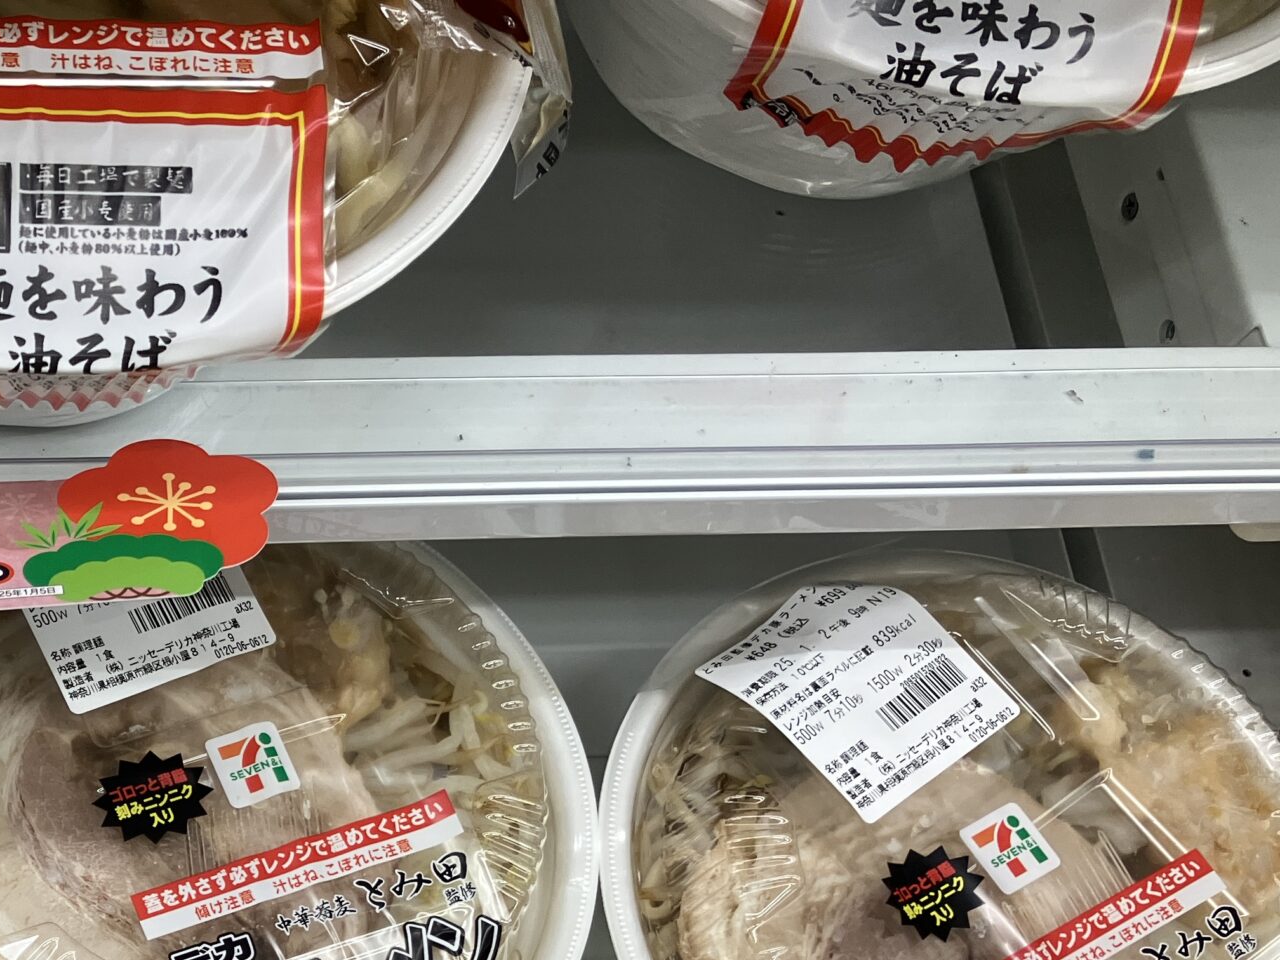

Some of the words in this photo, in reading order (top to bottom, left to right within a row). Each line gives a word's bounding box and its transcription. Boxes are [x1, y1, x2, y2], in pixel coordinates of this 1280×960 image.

[51, 52, 255, 75] 汁はね、こぼれに注意
[880, 42, 1044, 104] 油そば
[8, 330, 176, 376] 油そば
[872, 613, 917, 647] 839kcal
[51, 648, 72, 662] 名称
[214, 634, 269, 659] 0120-06-0612
[57, 658, 87, 674] 内容量
[62, 671, 94, 690] 製造者
[783, 688, 842, 732] レンジ加熱目安
[969, 706, 1015, 743] 0120-06-0612
[825, 758, 843, 775] 名称
[836, 766, 860, 786] 内容量
[846, 777, 873, 800] 製造者
[115, 784, 194, 821] 刻みニンニク
[150, 808, 175, 828] 入り
[141, 800, 444, 913] 蓋を外さず必ずレンジで温めてください
[194, 890, 256, 920] 傾け注意
[272, 838, 413, 894] 汁はね、こぼれに注意
[275, 895, 356, 935] 中華蕎麦
[355, 851, 468, 911] とみ田
[444, 883, 477, 906] 監修
[930, 904, 954, 926] 入り
[1227, 934, 1259, 960] 監修
